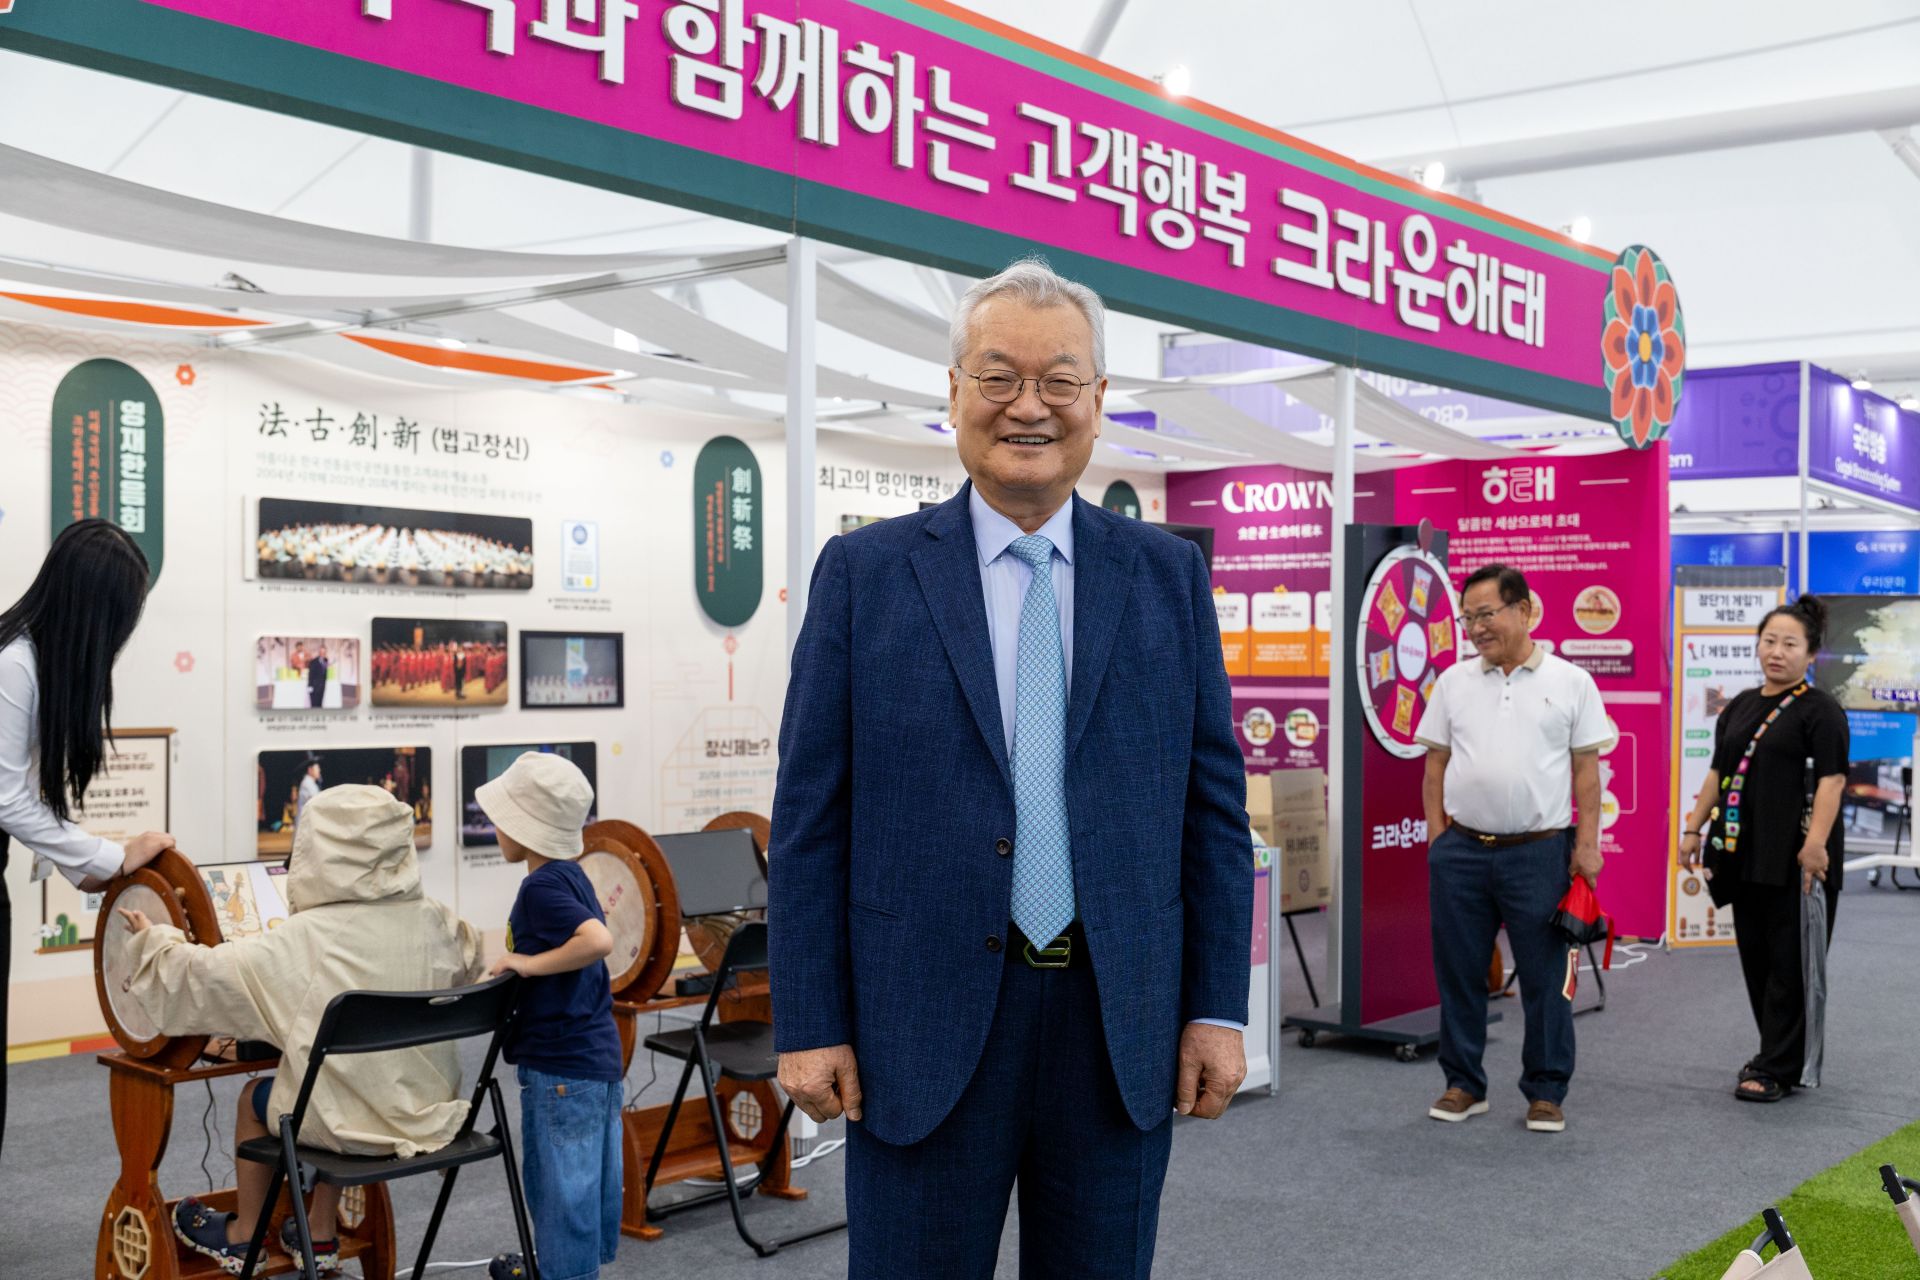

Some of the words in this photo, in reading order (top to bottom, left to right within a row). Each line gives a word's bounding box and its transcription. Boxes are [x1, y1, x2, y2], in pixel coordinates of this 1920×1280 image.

[661, 0, 996, 194] 함께하는
[1009, 101, 1250, 268] 고객행복
[1271, 187, 1547, 348] 크라운해태
[431, 426, 530, 461] (법고창신)
[818, 465, 870, 493] 최고의
[875, 470, 941, 500] 명인명창
